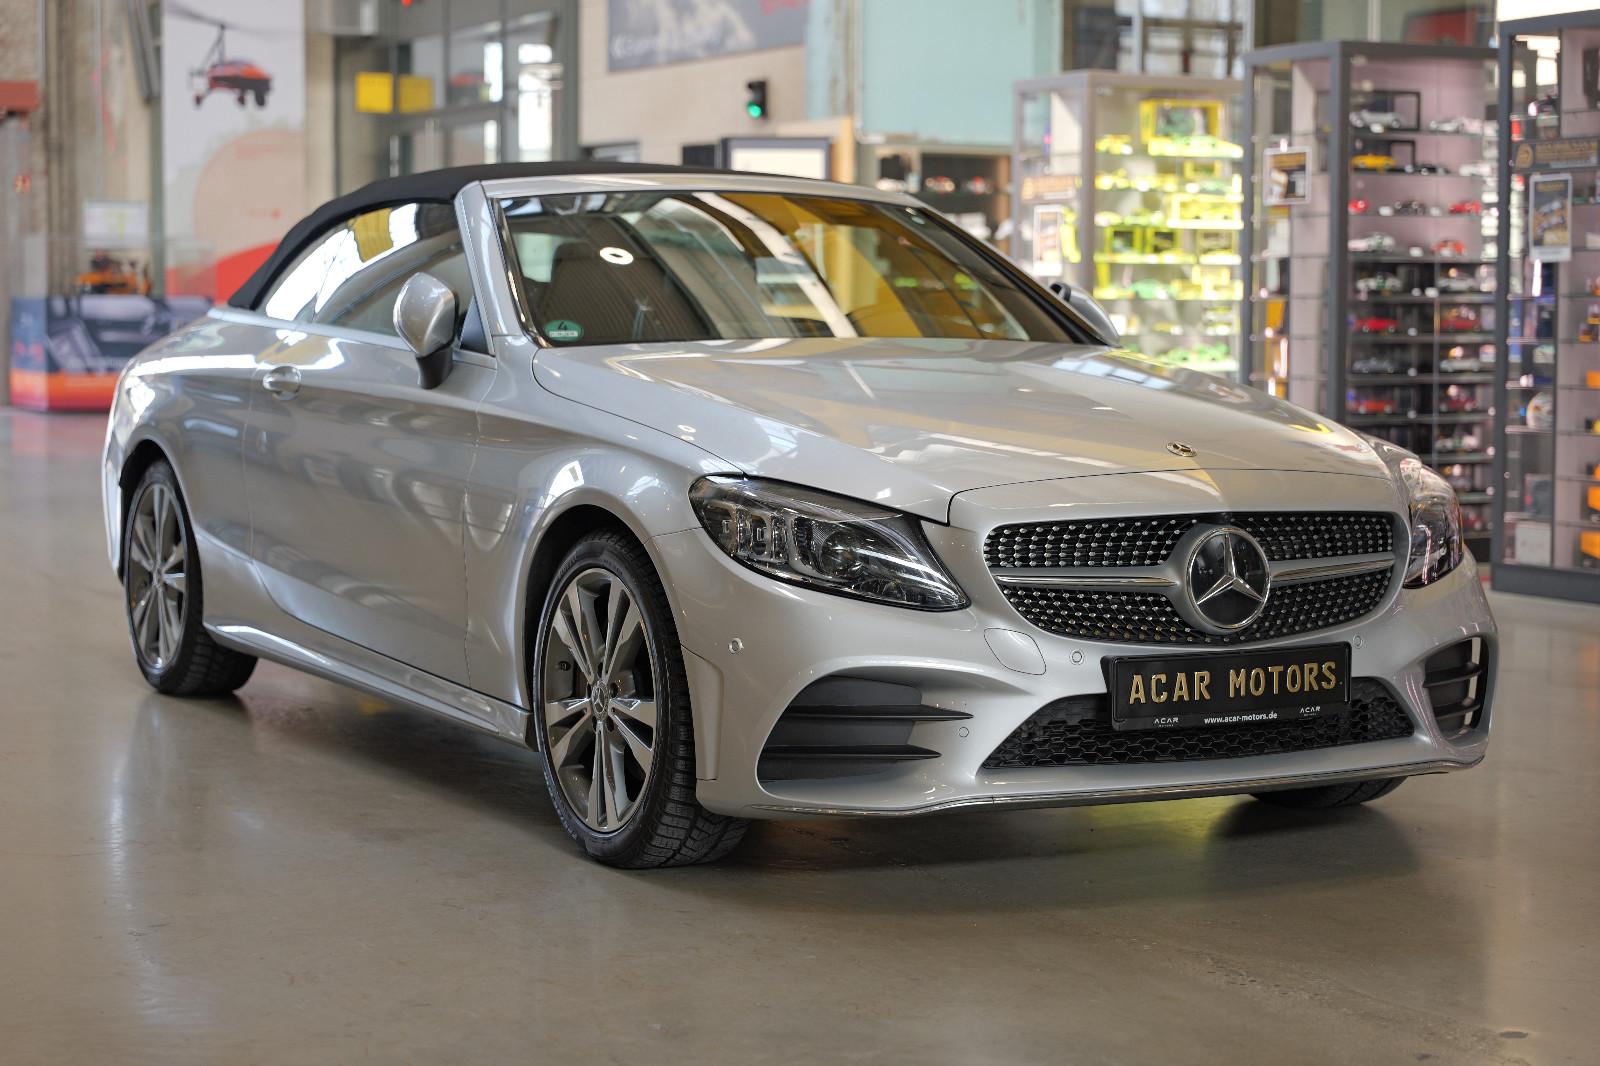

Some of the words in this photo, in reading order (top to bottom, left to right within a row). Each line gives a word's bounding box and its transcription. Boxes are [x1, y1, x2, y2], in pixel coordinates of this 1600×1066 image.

[1129, 671, 1211, 704] ACAR
[1229, 662, 1336, 698] MOTORS
[1203, 711, 1278, 724] www.acar-motors.de
